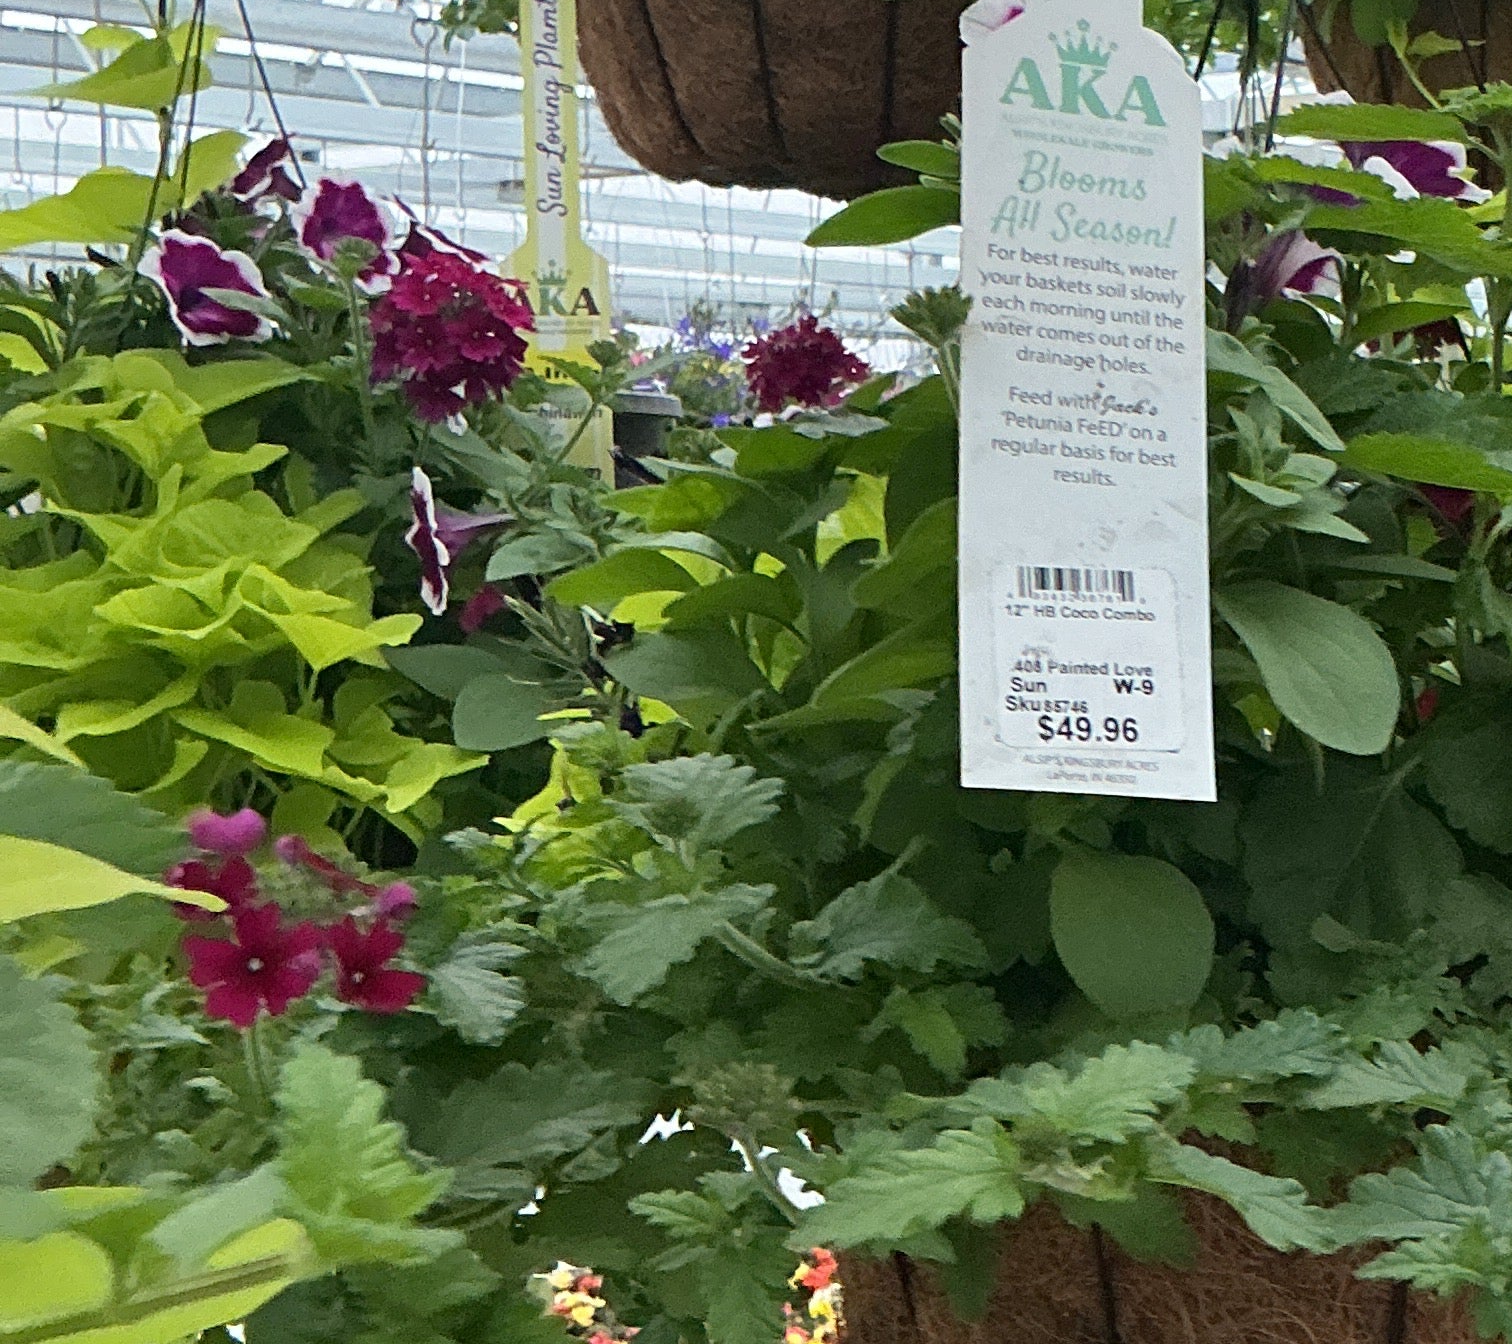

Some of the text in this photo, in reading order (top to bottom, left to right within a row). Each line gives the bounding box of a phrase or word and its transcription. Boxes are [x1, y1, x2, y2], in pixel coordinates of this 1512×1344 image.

[999, 57, 1167, 128] AKA
[535, 75, 574, 164] Loving
[1018, 149, 1147, 201] Blooms
[536, 167, 568, 218] Sun
[990, 195, 1178, 249] All Season!
[987, 243, 1178, 281] For best results, water
[978, 267, 1186, 309] your baskets soil slowly
[981, 294, 1184, 330] each morning until the
[980, 319, 1185, 355] water comes out of the
[1015, 345, 1152, 375] drainage holes.
[1008, 385, 1053, 407] Feed
[1057, 392, 1097, 411] with
[1129, 426, 1153, 442] on
[1157, 429, 1168, 443] a
[991, 437, 1177, 468] regular basis for best
[1053, 467, 1118, 487] results.
[1033, 605, 1056, 619] HB
[1060, 606, 1099, 620] Coco
[1102, 607, 1156, 622] Combo
[1048, 660, 1110, 676] Painted
[1113, 662, 1154, 677] Love
[1010, 676, 1154, 696] Sun W-9
[1038, 714, 1139, 743] $49.96
